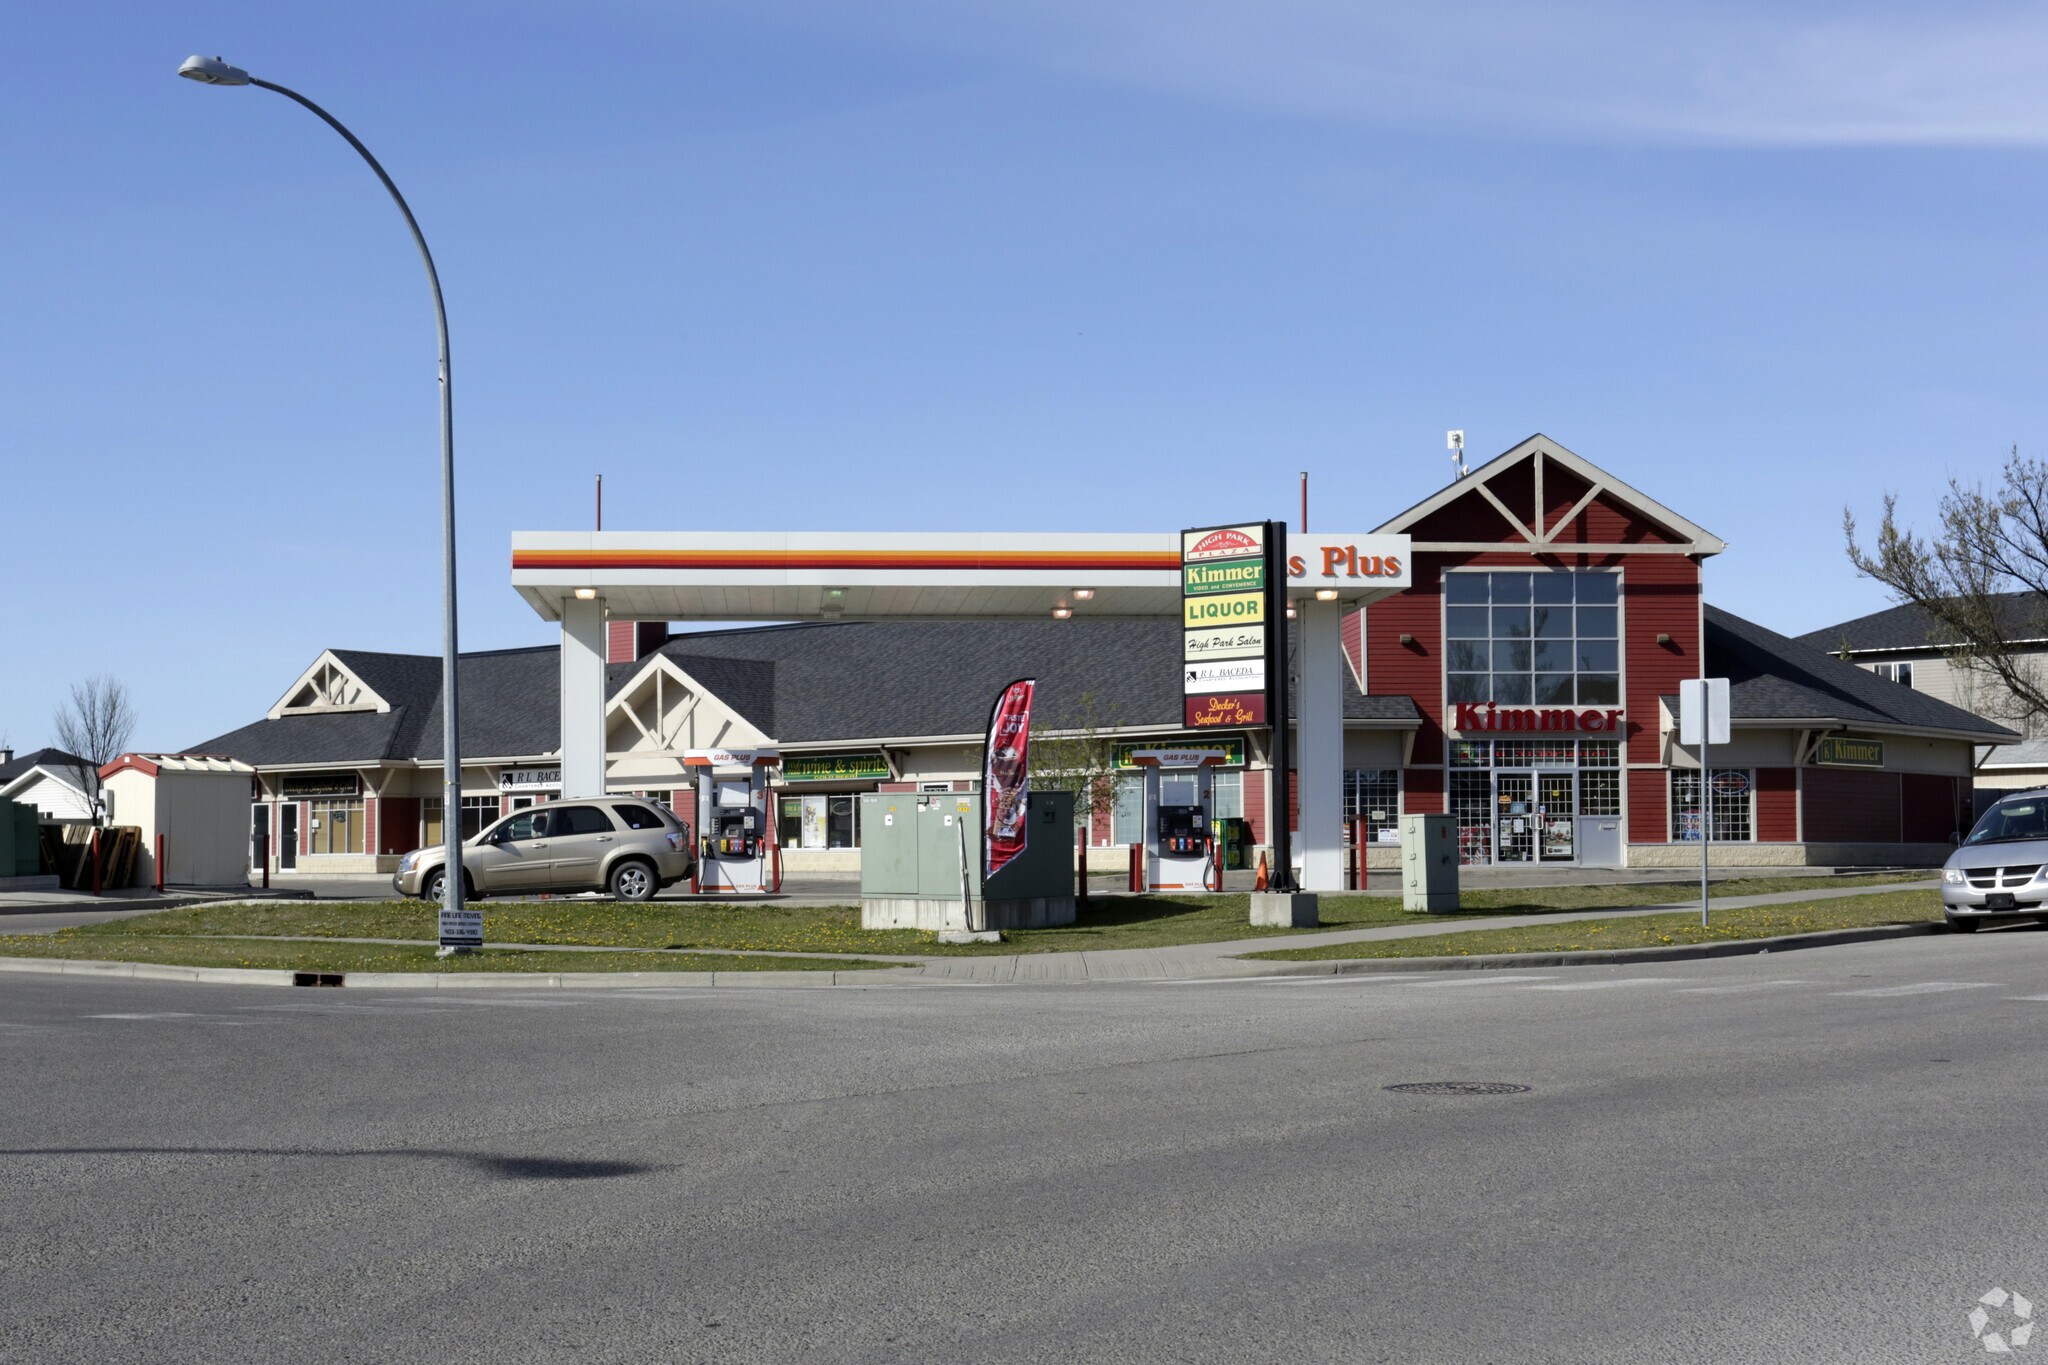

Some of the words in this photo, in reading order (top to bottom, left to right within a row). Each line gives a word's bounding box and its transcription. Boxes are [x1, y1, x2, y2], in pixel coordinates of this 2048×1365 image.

[1198, 533, 1222, 550] HIGH
[1226, 532, 1250, 545] PARK
[1199, 547, 1250, 557] PLAZA
[1320, 545, 1402, 578] Plus
[1187, 565, 1263, 584] Kimmer
[1222, 581, 1257, 589] CONVENIENCE
[1189, 600, 1258, 620] LIQUOR
[1188, 639, 1209, 652] High
[1212, 637, 1233, 649] Park
[1237, 635, 1261, 646] Salon
[1208, 669, 1214, 677] L
[1219, 667, 1253, 677] BACEDA
[1208, 697, 1240, 712] Decker's
[1003, 714, 1025, 722] TASTE
[1194, 711, 1224, 726] Seafood
[1235, 709, 1254, 724] Grill
[1454, 701, 1625, 732] Kimmer
[1002, 722, 1025, 733] JOY
[1835, 740, 1880, 760] Kimmer
[802, 758, 831, 775] wine
[835, 759, 846, 773] &
[849, 755, 888, 778] spirits
[517, 772, 524, 782] R
[526, 772, 532, 782] L
[537, 771, 561, 782] BACE
[757, 791, 764, 800] 3
[1203, 790, 1210, 799] 2
